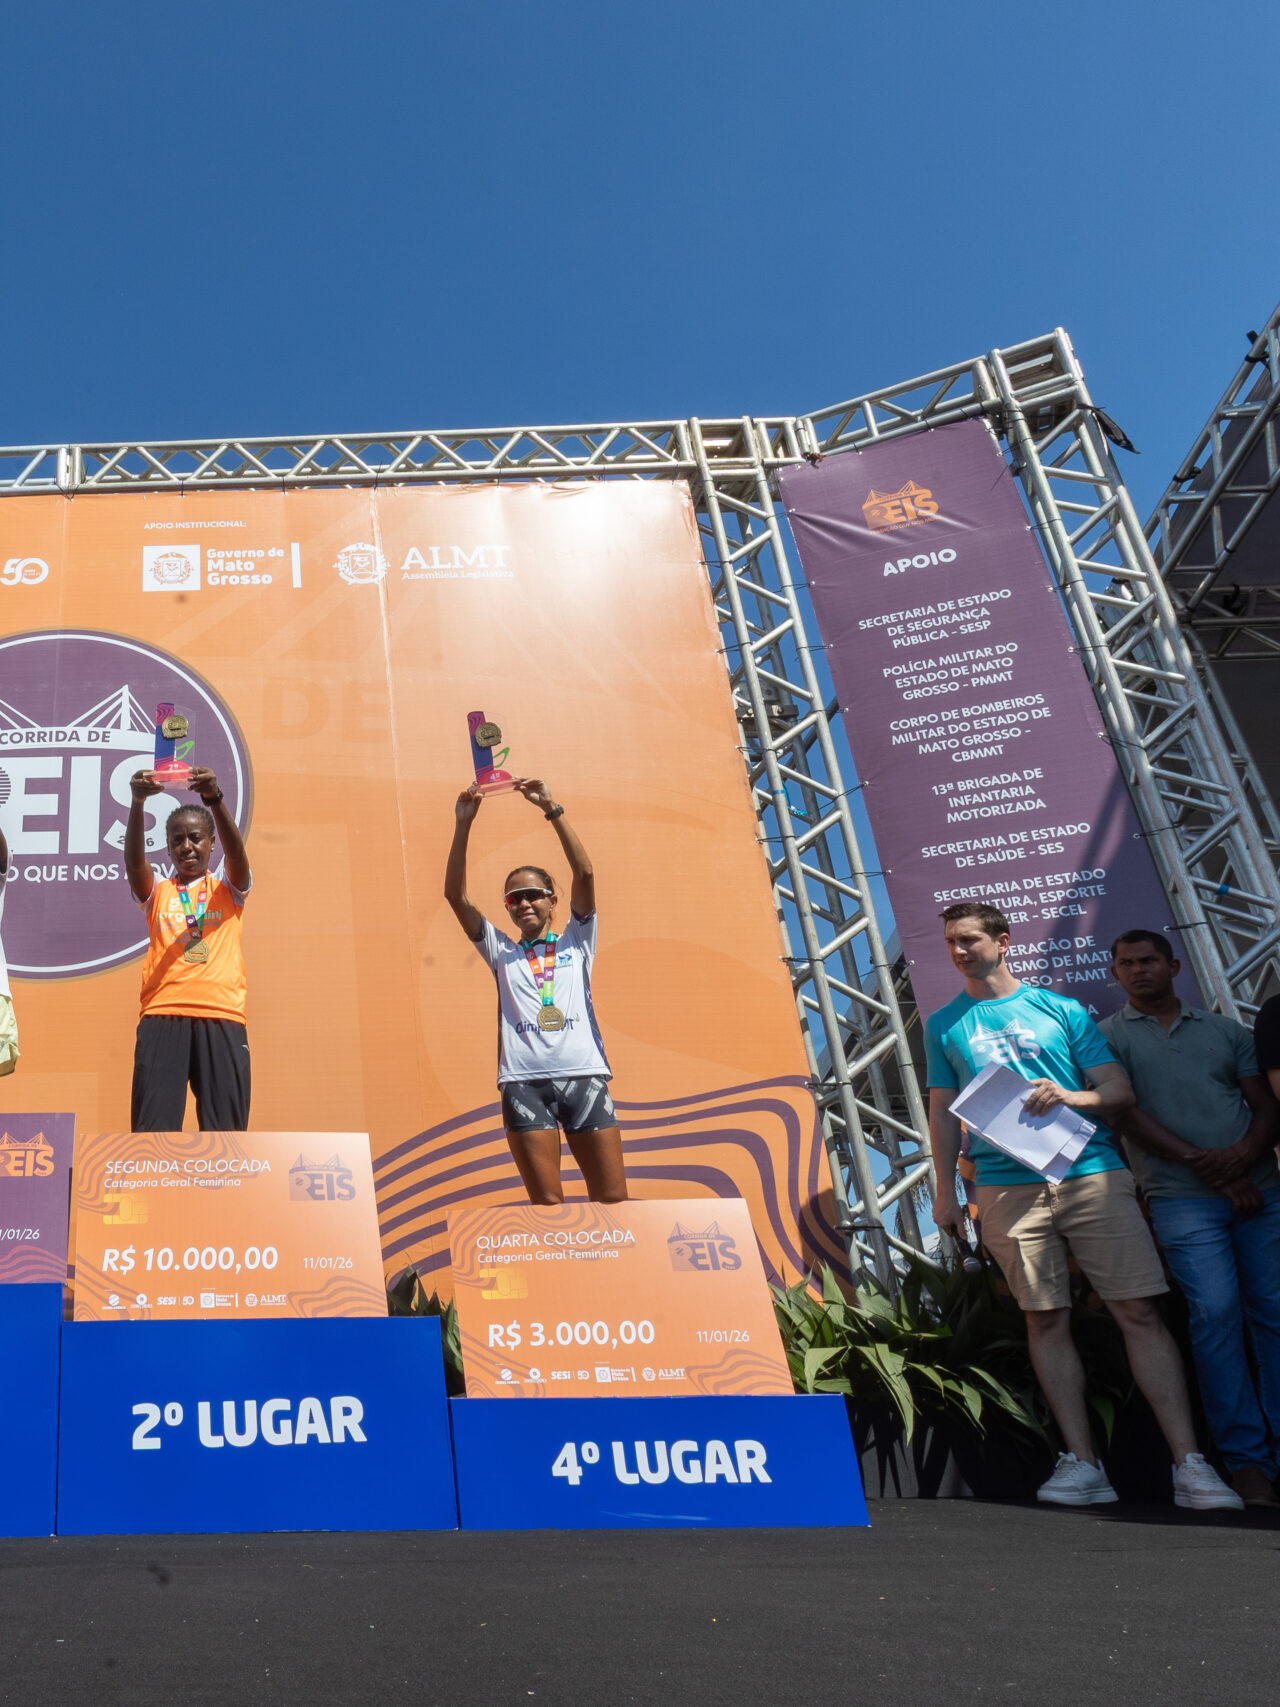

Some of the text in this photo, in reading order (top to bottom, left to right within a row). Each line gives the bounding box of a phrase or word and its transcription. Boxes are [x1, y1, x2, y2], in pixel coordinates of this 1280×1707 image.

[175, 520, 246, 528] INSTITUCIONAL:
[207, 547, 284, 559] Governo de
[401, 545, 511, 570] ALMT
[883, 548, 957, 577] APOIO
[207, 559, 255, 572] Mato
[207, 572, 273, 586] Grosso
[859, 589, 1011, 630] SECRETARIA DE ESTADO
[887, 607, 990, 636] DE SEGURANÇA
[883, 642, 1018, 678] POLÍCIA MILITAR DO
[895, 657, 1013, 688] ESTADO DE MATO
[890, 694, 1045, 730] CORPO DE BOMBEIROS
[87, 730, 111, 743] DE
[892, 707, 1051, 745] MILITAR DO ESTADO DE
[952, 744, 1004, 762] CBMMT
[957, 772, 1022, 791] BRIGADA
[1023, 768, 1044, 780] DE
[948, 785, 1036, 808] INFANTARIA
[947, 798, 1047, 823] MOTORIZADA
[24, 865, 68, 883] QUE
[74, 864, 119, 881] NOS
[105, 1159, 272, 1174] SEGUNDA COLOCADA
[476, 1229, 635, 1250] QUARTA COLOCADA
[102, 1245, 278, 1275] R$ 10.000,00
[304, 1257, 353, 1270] 11/01/26
[488, 1320, 655, 1351] R$ 3.000,00
[696, 1330, 750, 1344] 11/01/26
[198, 1396, 367, 1448] LUGAR
[611, 1440, 772, 1484] LUGAR
